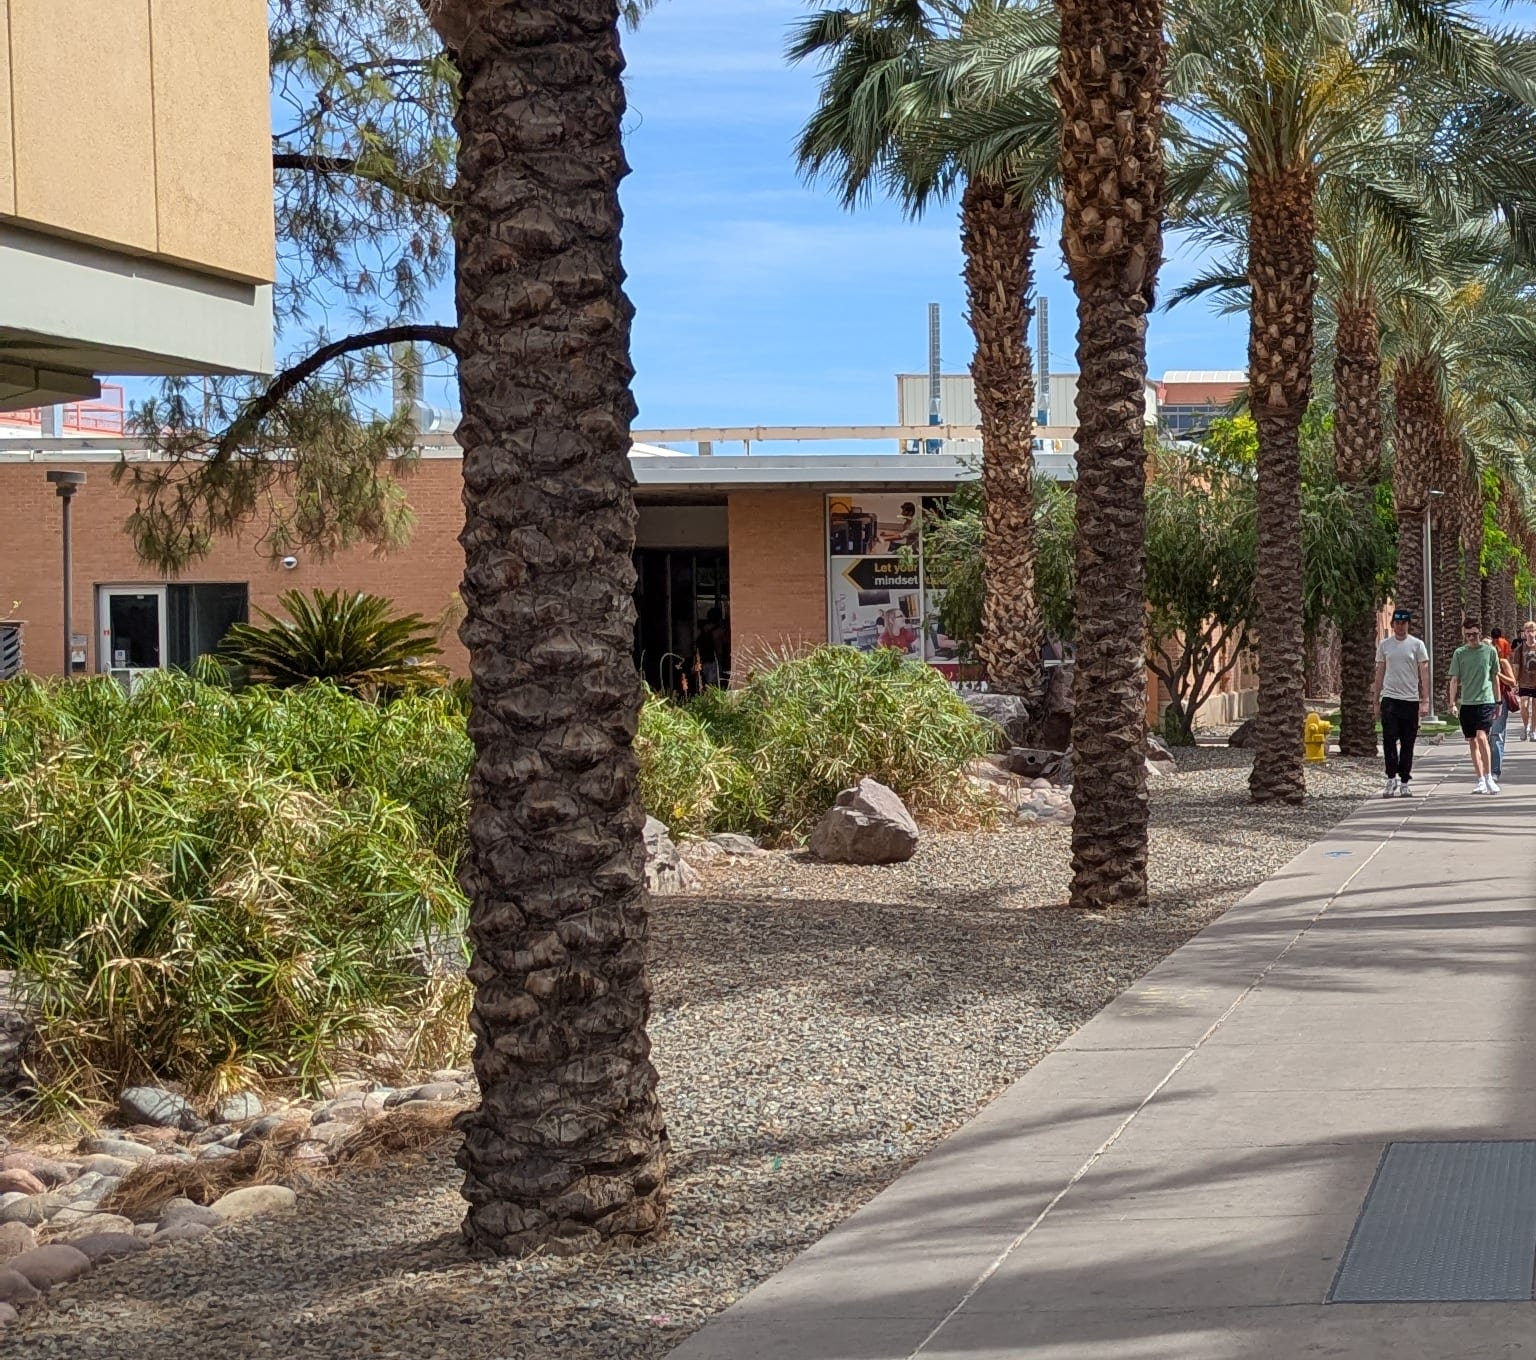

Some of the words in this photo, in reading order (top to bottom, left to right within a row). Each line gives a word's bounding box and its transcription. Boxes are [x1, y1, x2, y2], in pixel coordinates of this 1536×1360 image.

[874, 562, 892, 573] Let
[894, 562, 917, 575] your
[874, 575, 919, 586] mindset
